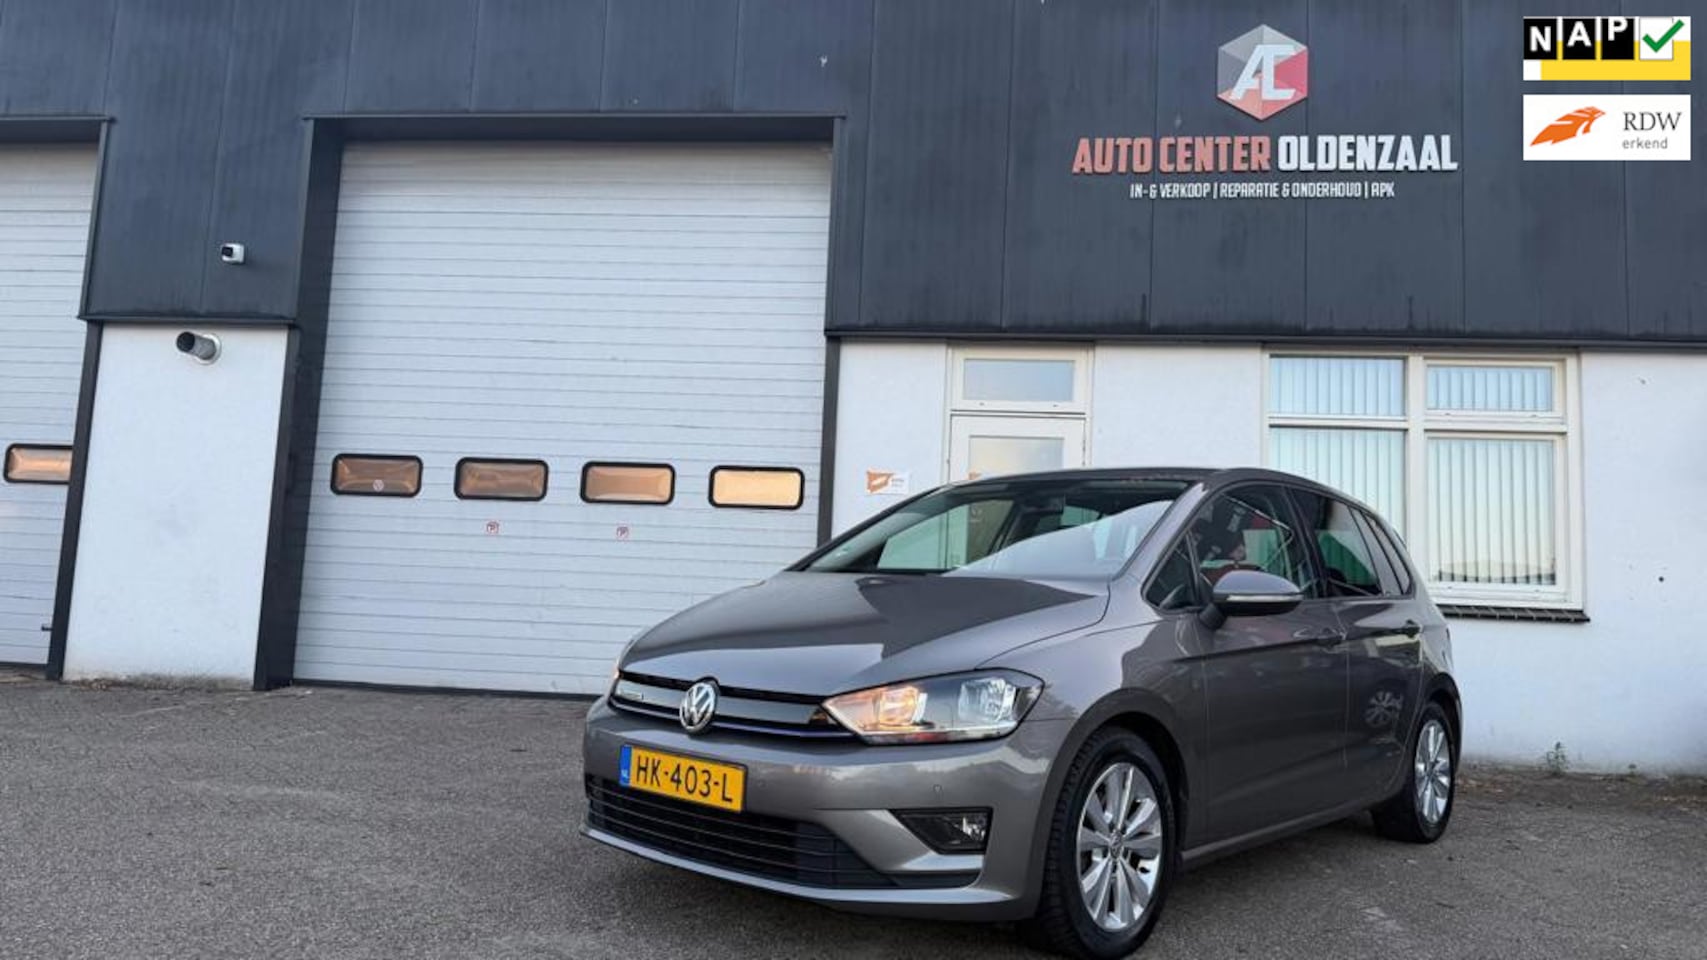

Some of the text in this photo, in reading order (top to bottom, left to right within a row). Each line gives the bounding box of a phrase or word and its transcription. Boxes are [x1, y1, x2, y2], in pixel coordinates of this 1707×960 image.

[1230, 43, 1297, 100] AC
[1072, 134, 1459, 174] AUTO CENTER OLDENZAAL
[1159, 182, 1211, 198] VERKOOP
[1220, 182, 1280, 198] REPARATIE
[1291, 182, 1363, 198] ONDERHOUD
[1370, 182, 1396, 198] APK
[637, 755, 733, 802] HK-403-L
